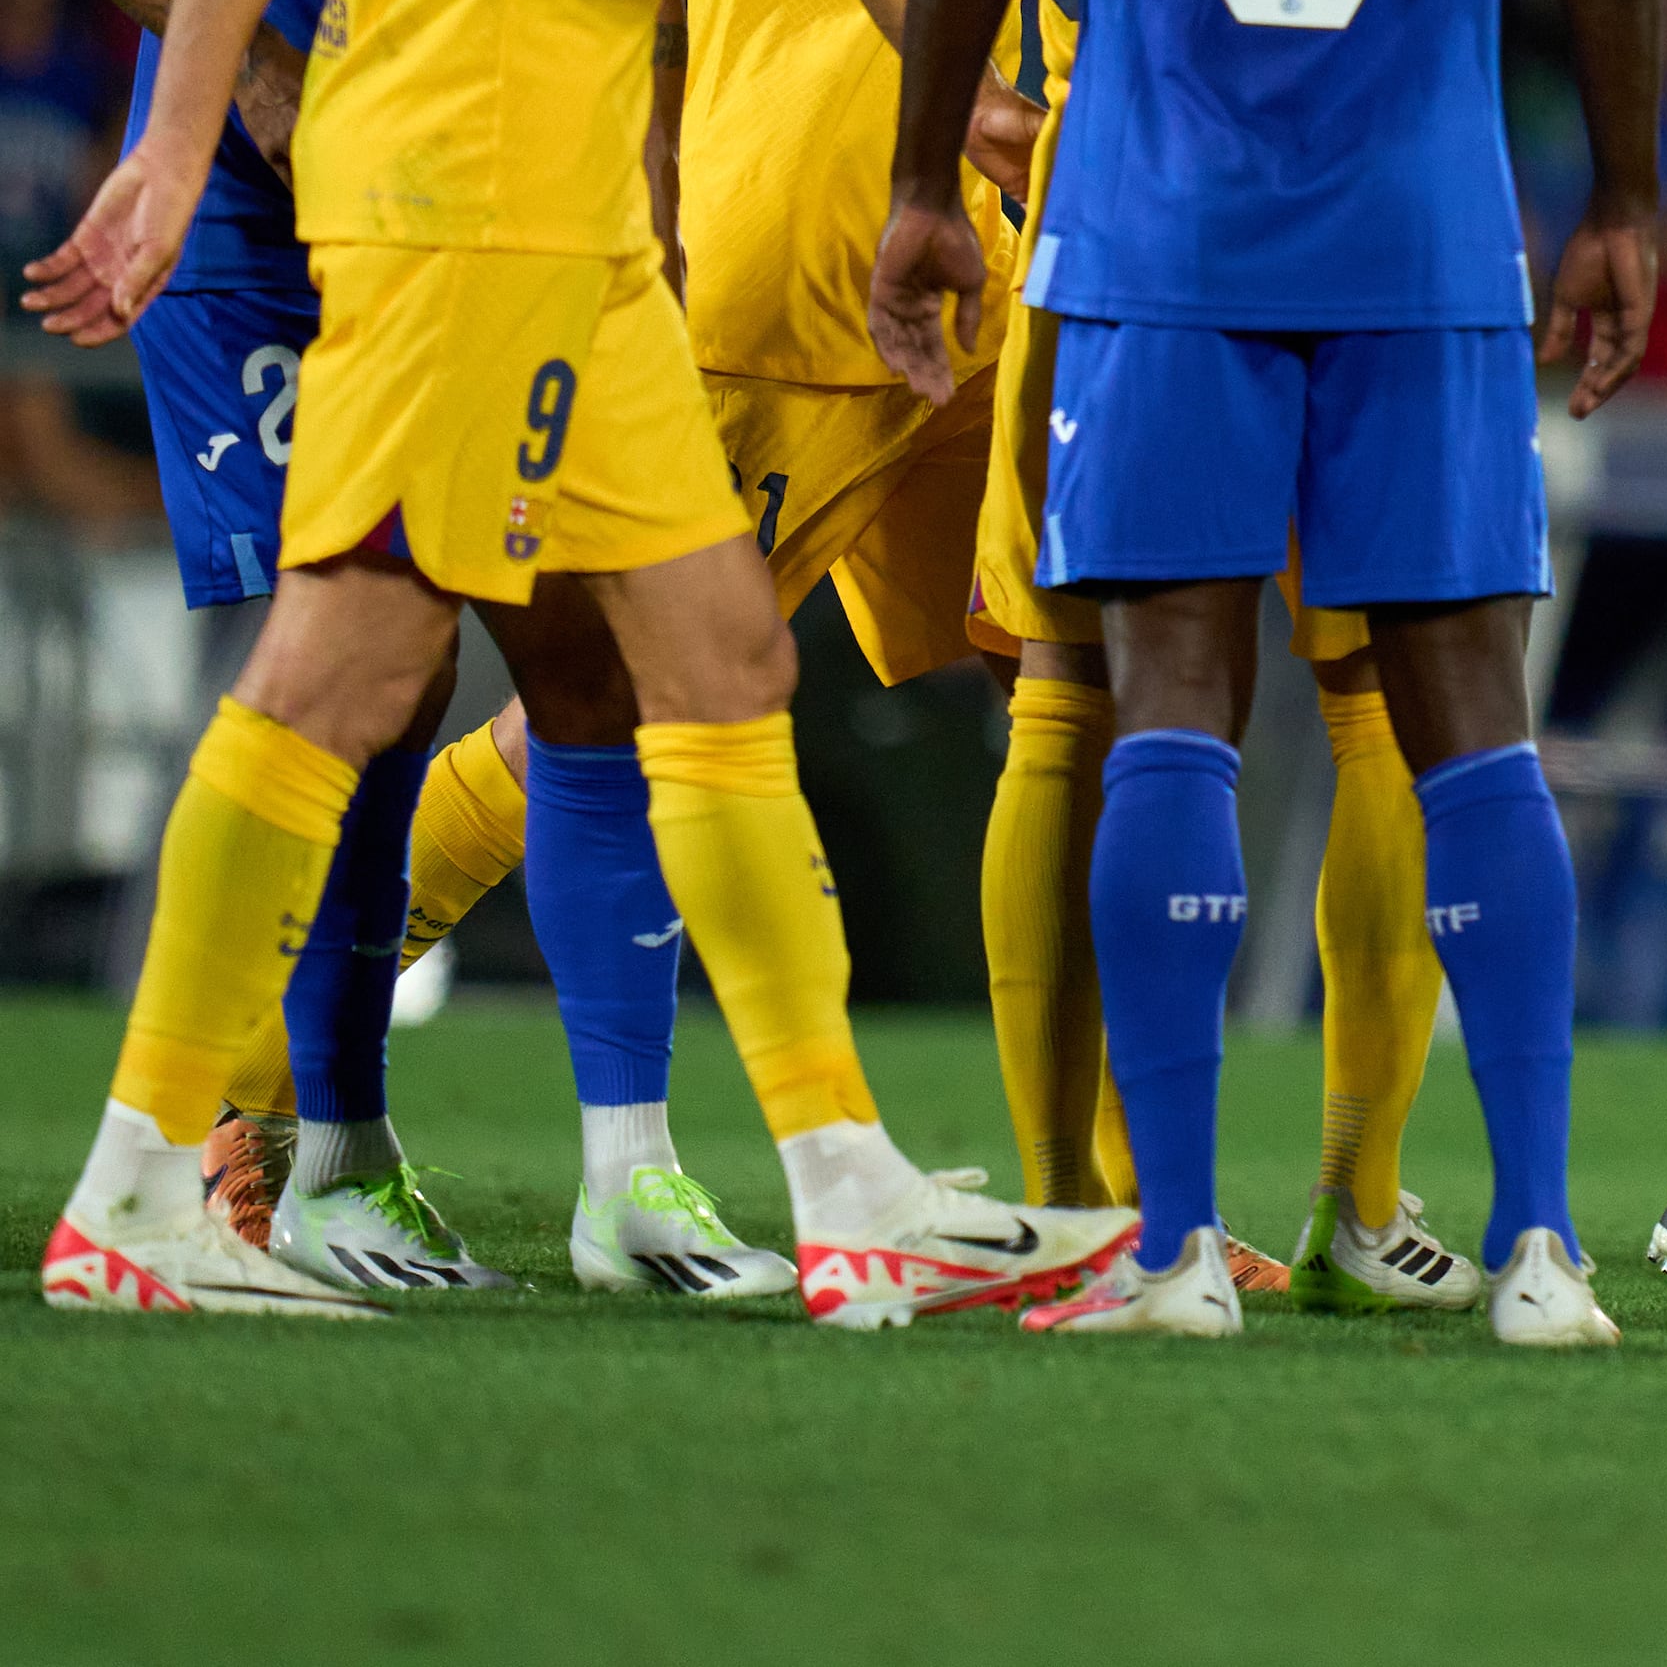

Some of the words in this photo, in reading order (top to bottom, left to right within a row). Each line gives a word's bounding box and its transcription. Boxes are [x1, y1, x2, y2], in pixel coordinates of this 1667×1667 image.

[242, 343, 300, 466] 2
[516, 358, 577, 481] 9
[729, 460, 789, 558] 1
[1424, 901, 1482, 937] TF
